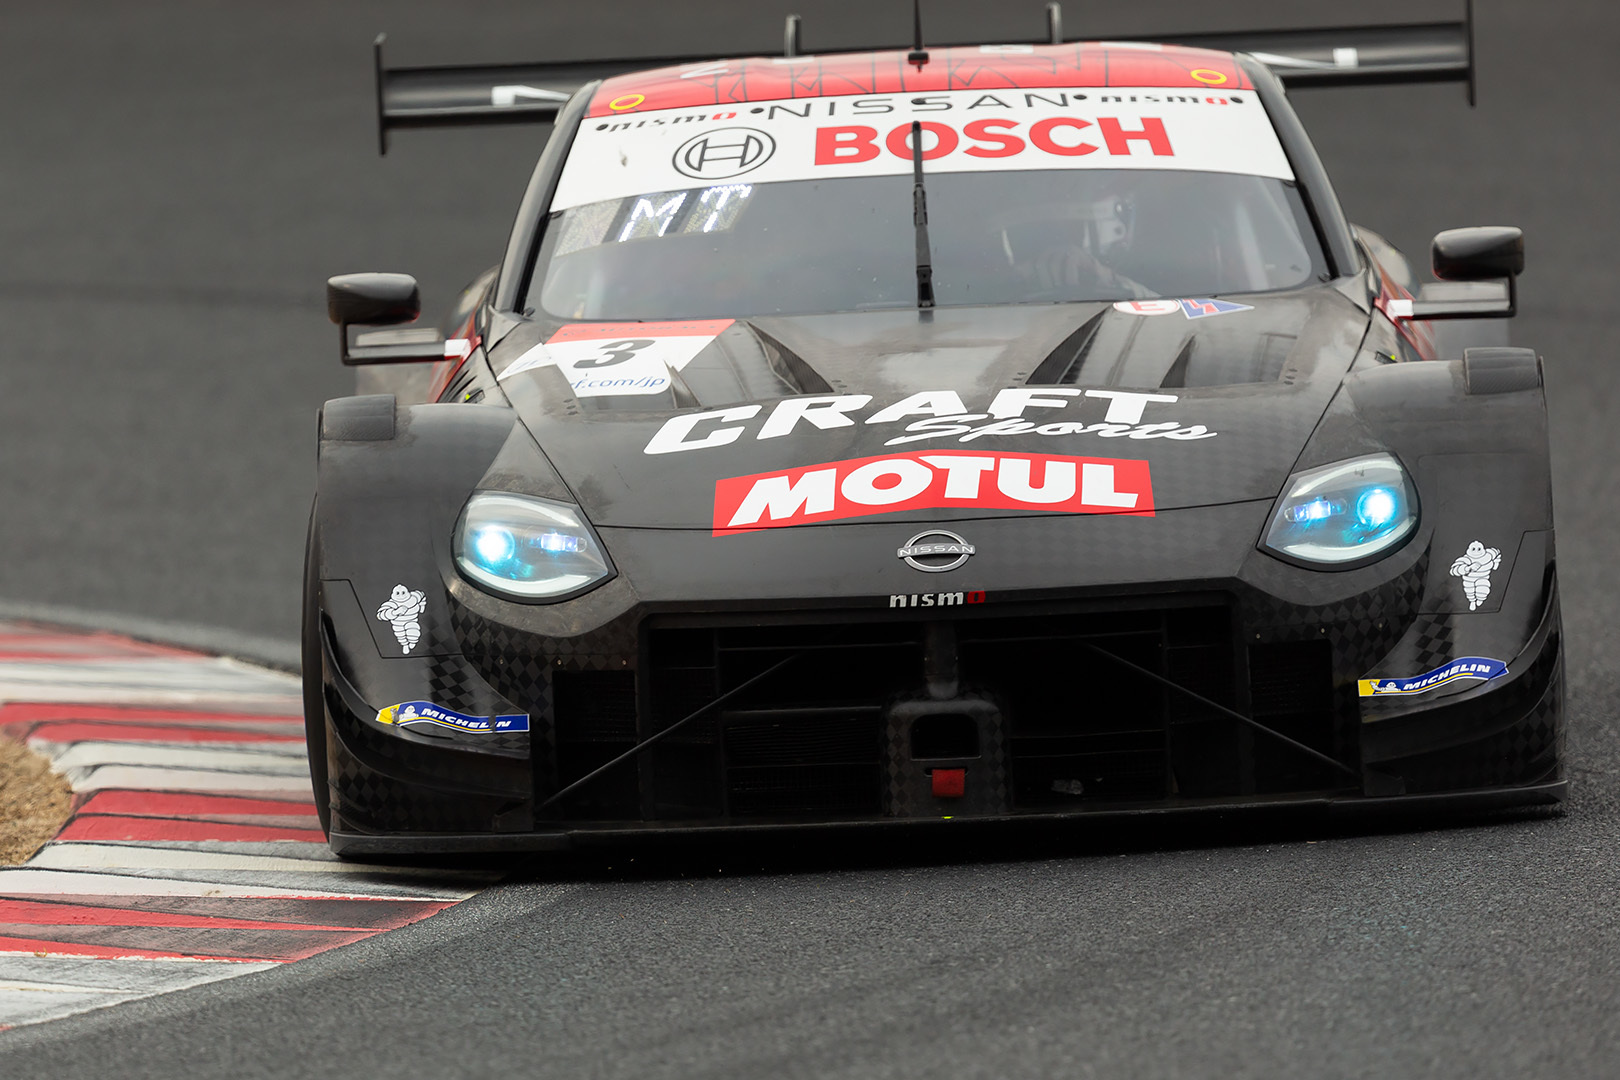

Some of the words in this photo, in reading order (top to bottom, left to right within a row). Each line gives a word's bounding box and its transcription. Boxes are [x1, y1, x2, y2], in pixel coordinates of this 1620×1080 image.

[768, 92, 1070, 120] NISSAN
[1100, 95, 1229, 106] nismo
[608, 112, 738, 133] nismo
[814, 116, 1176, 167] BOSCH
[572, 339, 657, 370] 3
[644, 388, 1179, 455] CRAFT
[883, 413, 1218, 446] Sports
[726, 455, 1139, 527] MOTUL
[899, 545, 974, 557] NISSAN
[889, 590, 986, 608] nismo
[1403, 663, 1491, 691] MICHELIN
[420, 707, 512, 729] MICHELN
